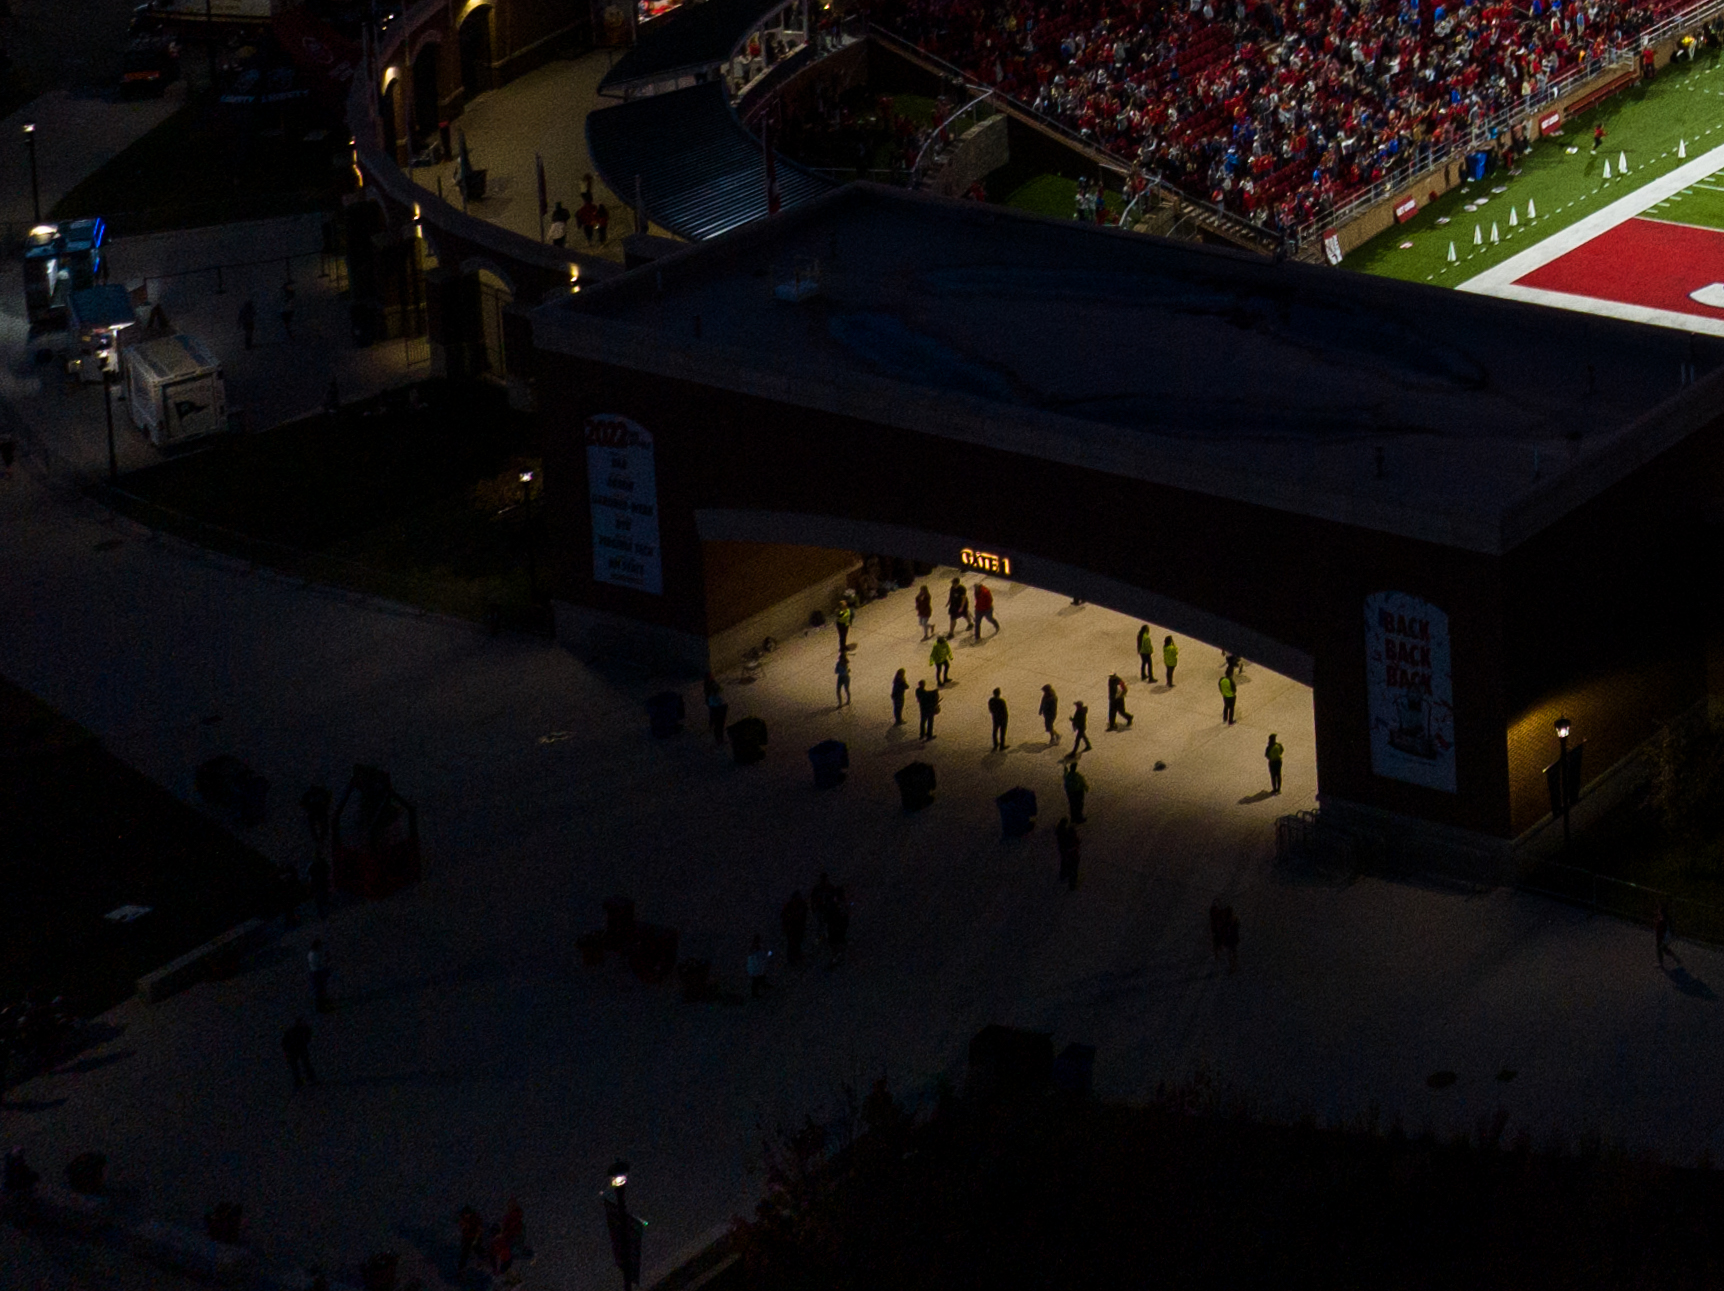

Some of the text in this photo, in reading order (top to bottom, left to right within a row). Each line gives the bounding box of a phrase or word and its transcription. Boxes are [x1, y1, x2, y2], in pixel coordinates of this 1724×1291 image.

[582, 420, 627, 448] 2022
[960, 548, 1011, 575] GATE 1
[1383, 611, 1430, 641] BACK
[1385, 638, 1431, 669] BACK
[1387, 665, 1433, 695] BACK
